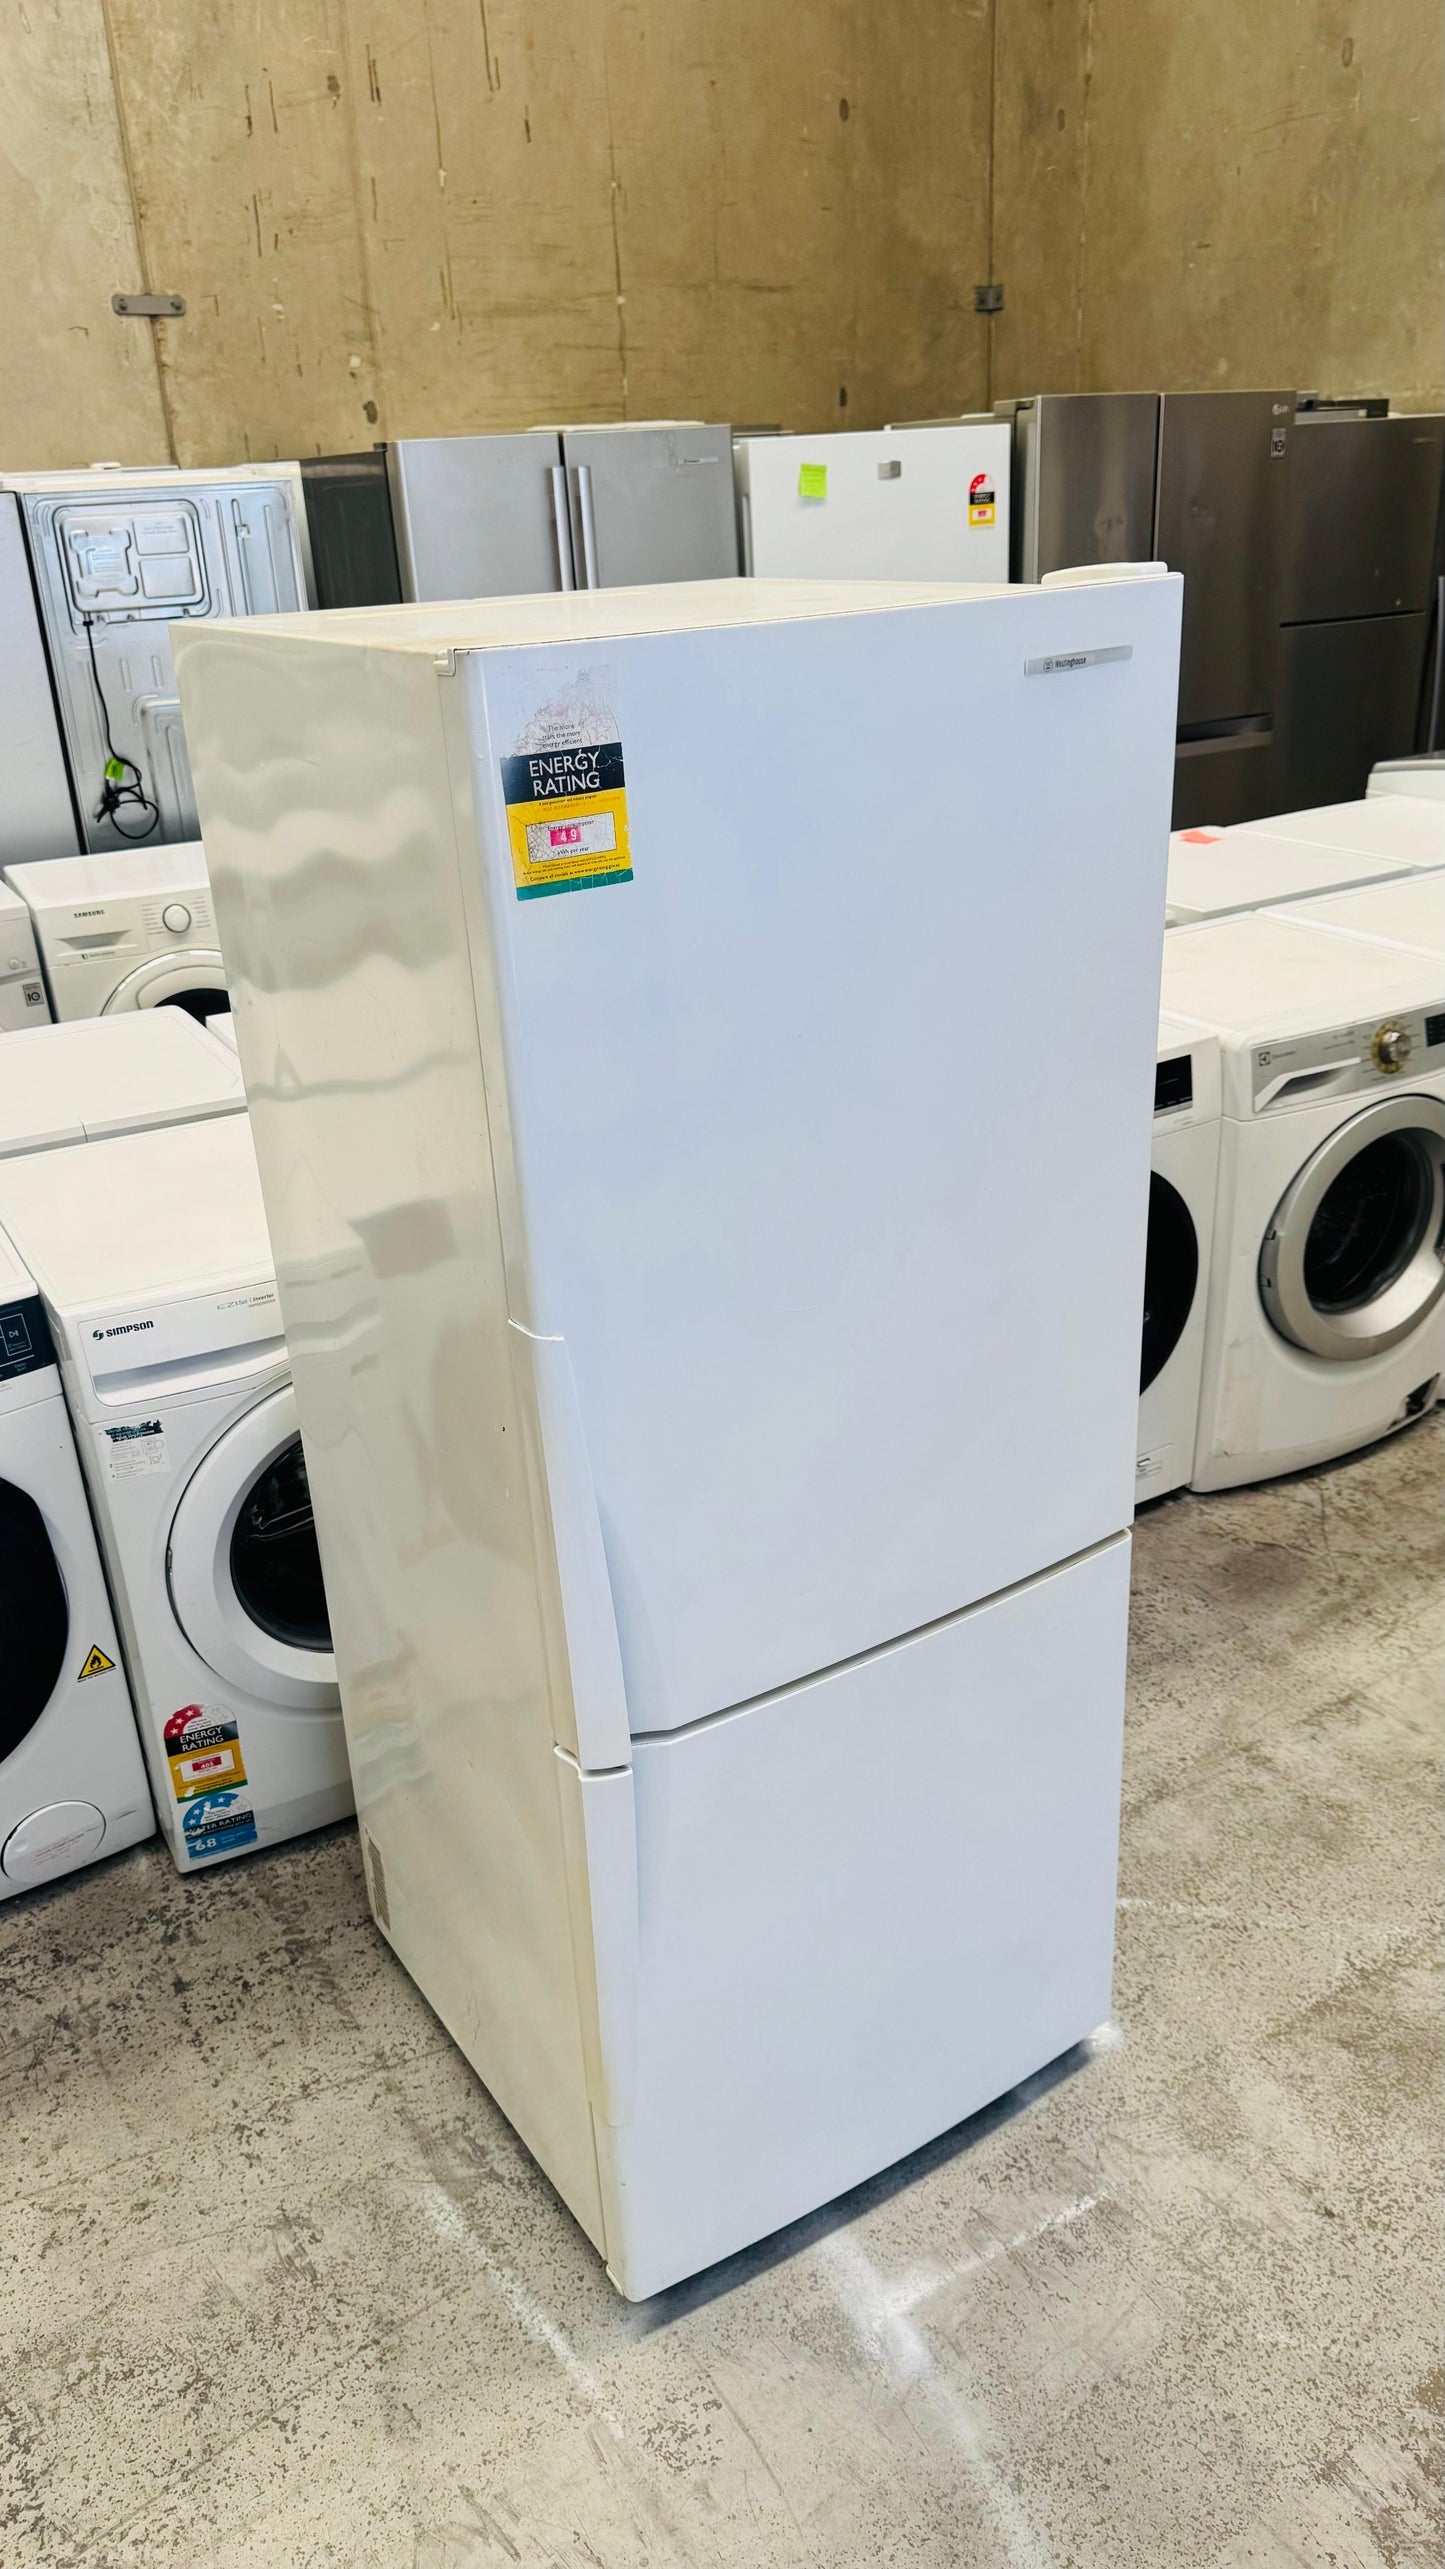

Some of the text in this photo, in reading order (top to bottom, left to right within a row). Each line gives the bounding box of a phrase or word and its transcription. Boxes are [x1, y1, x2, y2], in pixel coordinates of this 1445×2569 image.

[1055, 657, 1087, 668] Westinghouse
[566, 730, 581, 738] more
[529, 750, 600, 778] ENERGY
[532, 771, 601, 797] RATING
[73, 909, 106, 919] SAMSUNG
[106, 1320, 154, 1338] SIMPSON
[180, 1725, 222, 1744] ENERGY
[181, 1734, 224, 1753] RATING
[219, 1812, 252, 1827] RATING
